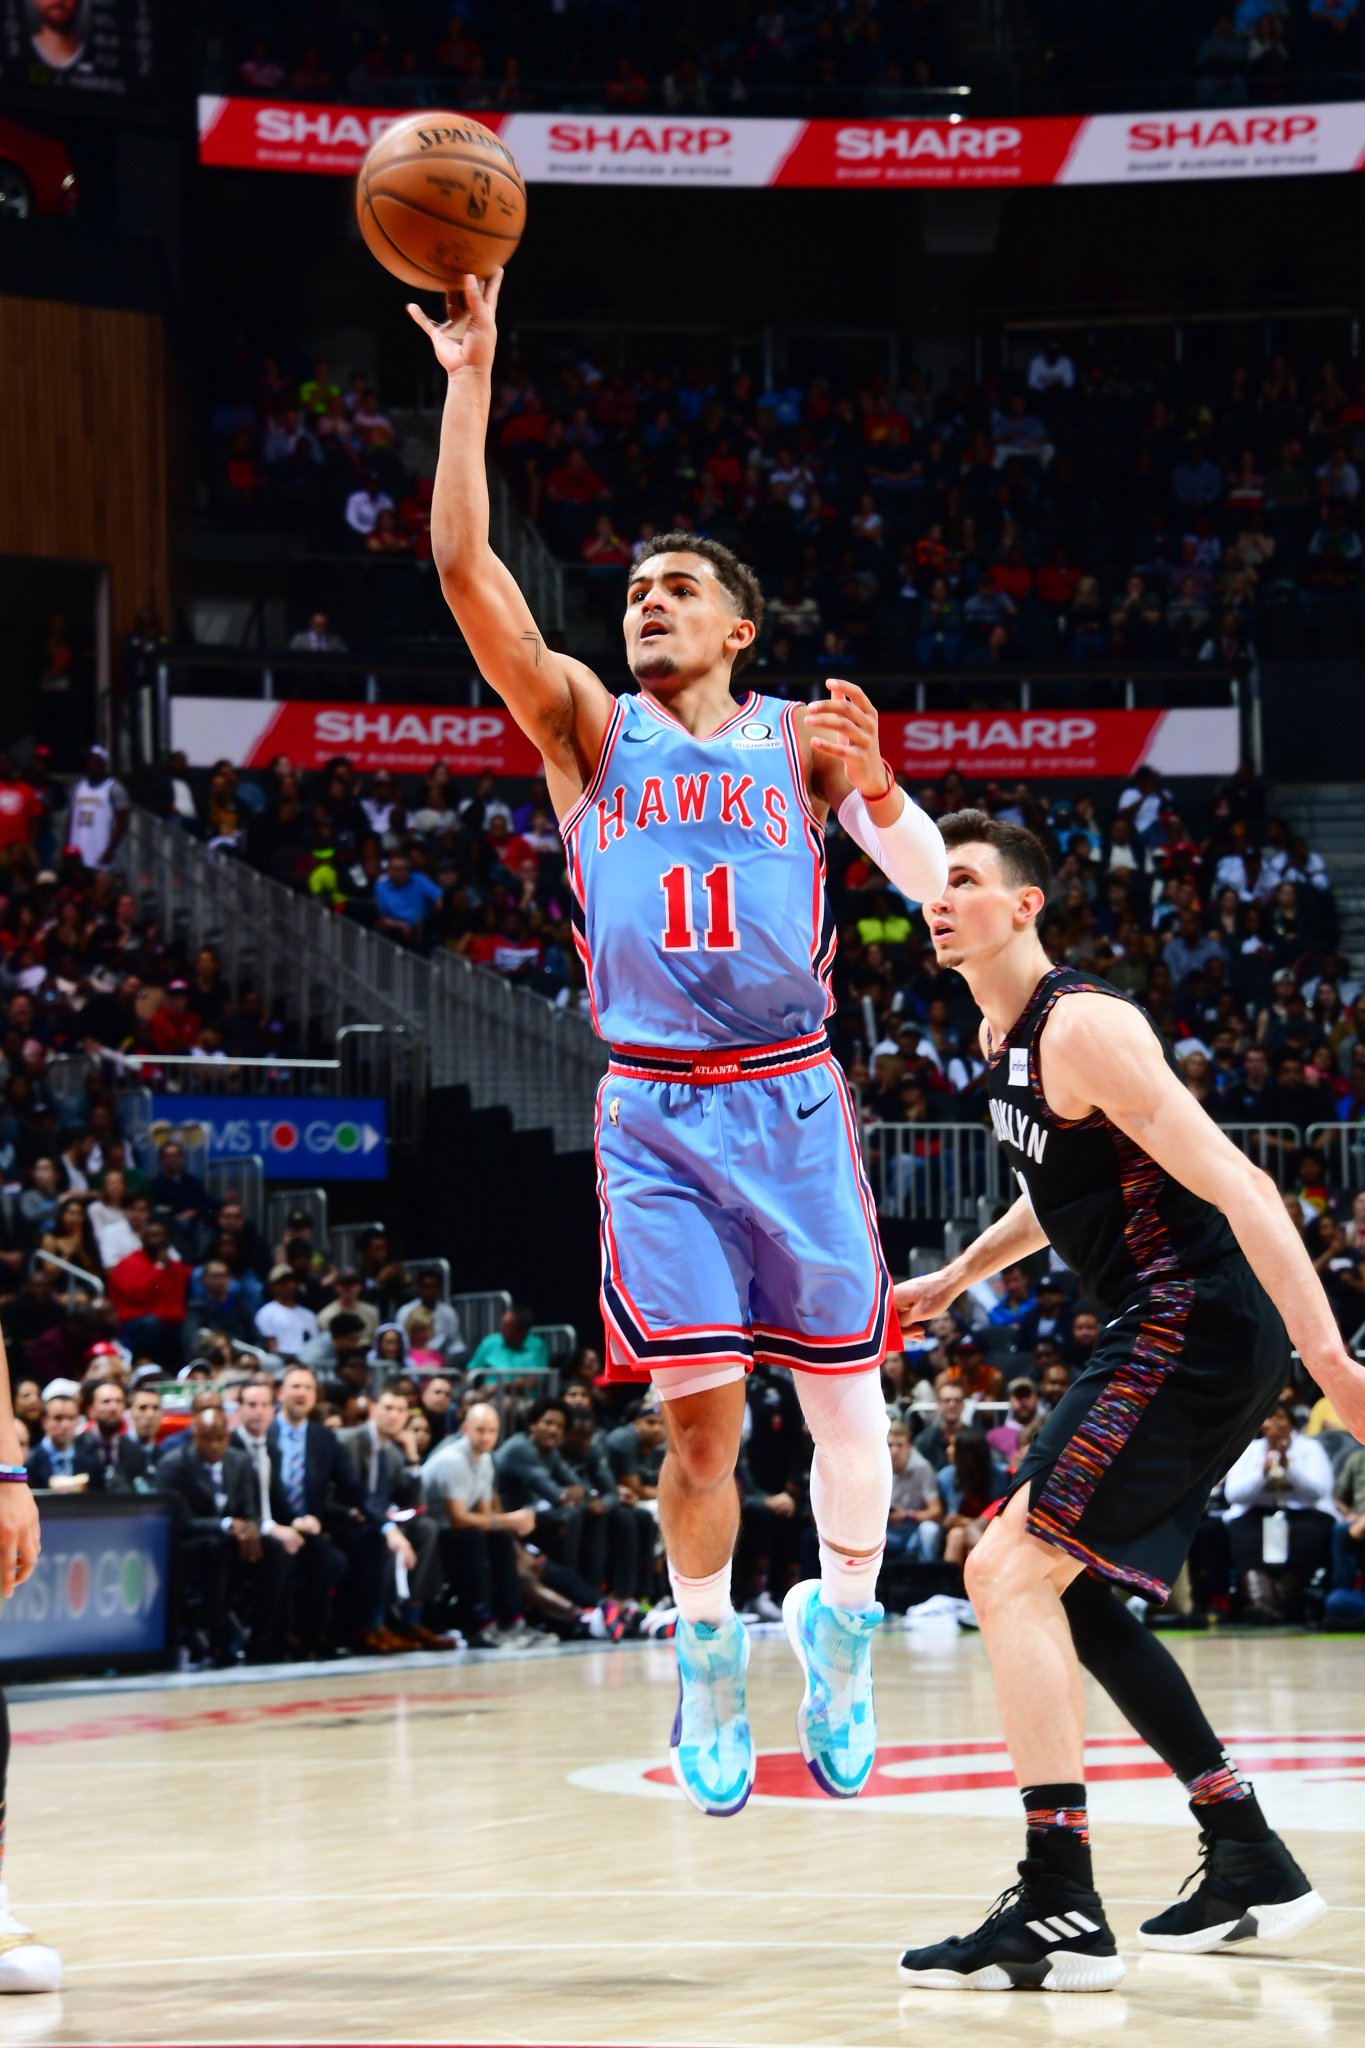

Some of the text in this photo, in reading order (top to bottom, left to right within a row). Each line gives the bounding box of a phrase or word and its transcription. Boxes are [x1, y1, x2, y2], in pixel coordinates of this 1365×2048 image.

[256, 108, 402, 148] SHA
[417, 128, 515, 164] SPALD
[548, 122, 733, 156] SHARP
[835, 126, 1022, 160] SHARP
[1128, 115, 1318, 153] SHARP
[314, 710, 505, 747] SHARP
[903, 716, 1096, 751] SHARP
[597, 771, 789, 852] HAWKS
[659, 863, 741, 952] 11
[694, 1064, 739, 1075] ATLANTA
[304, 1120, 360, 1153] GO
